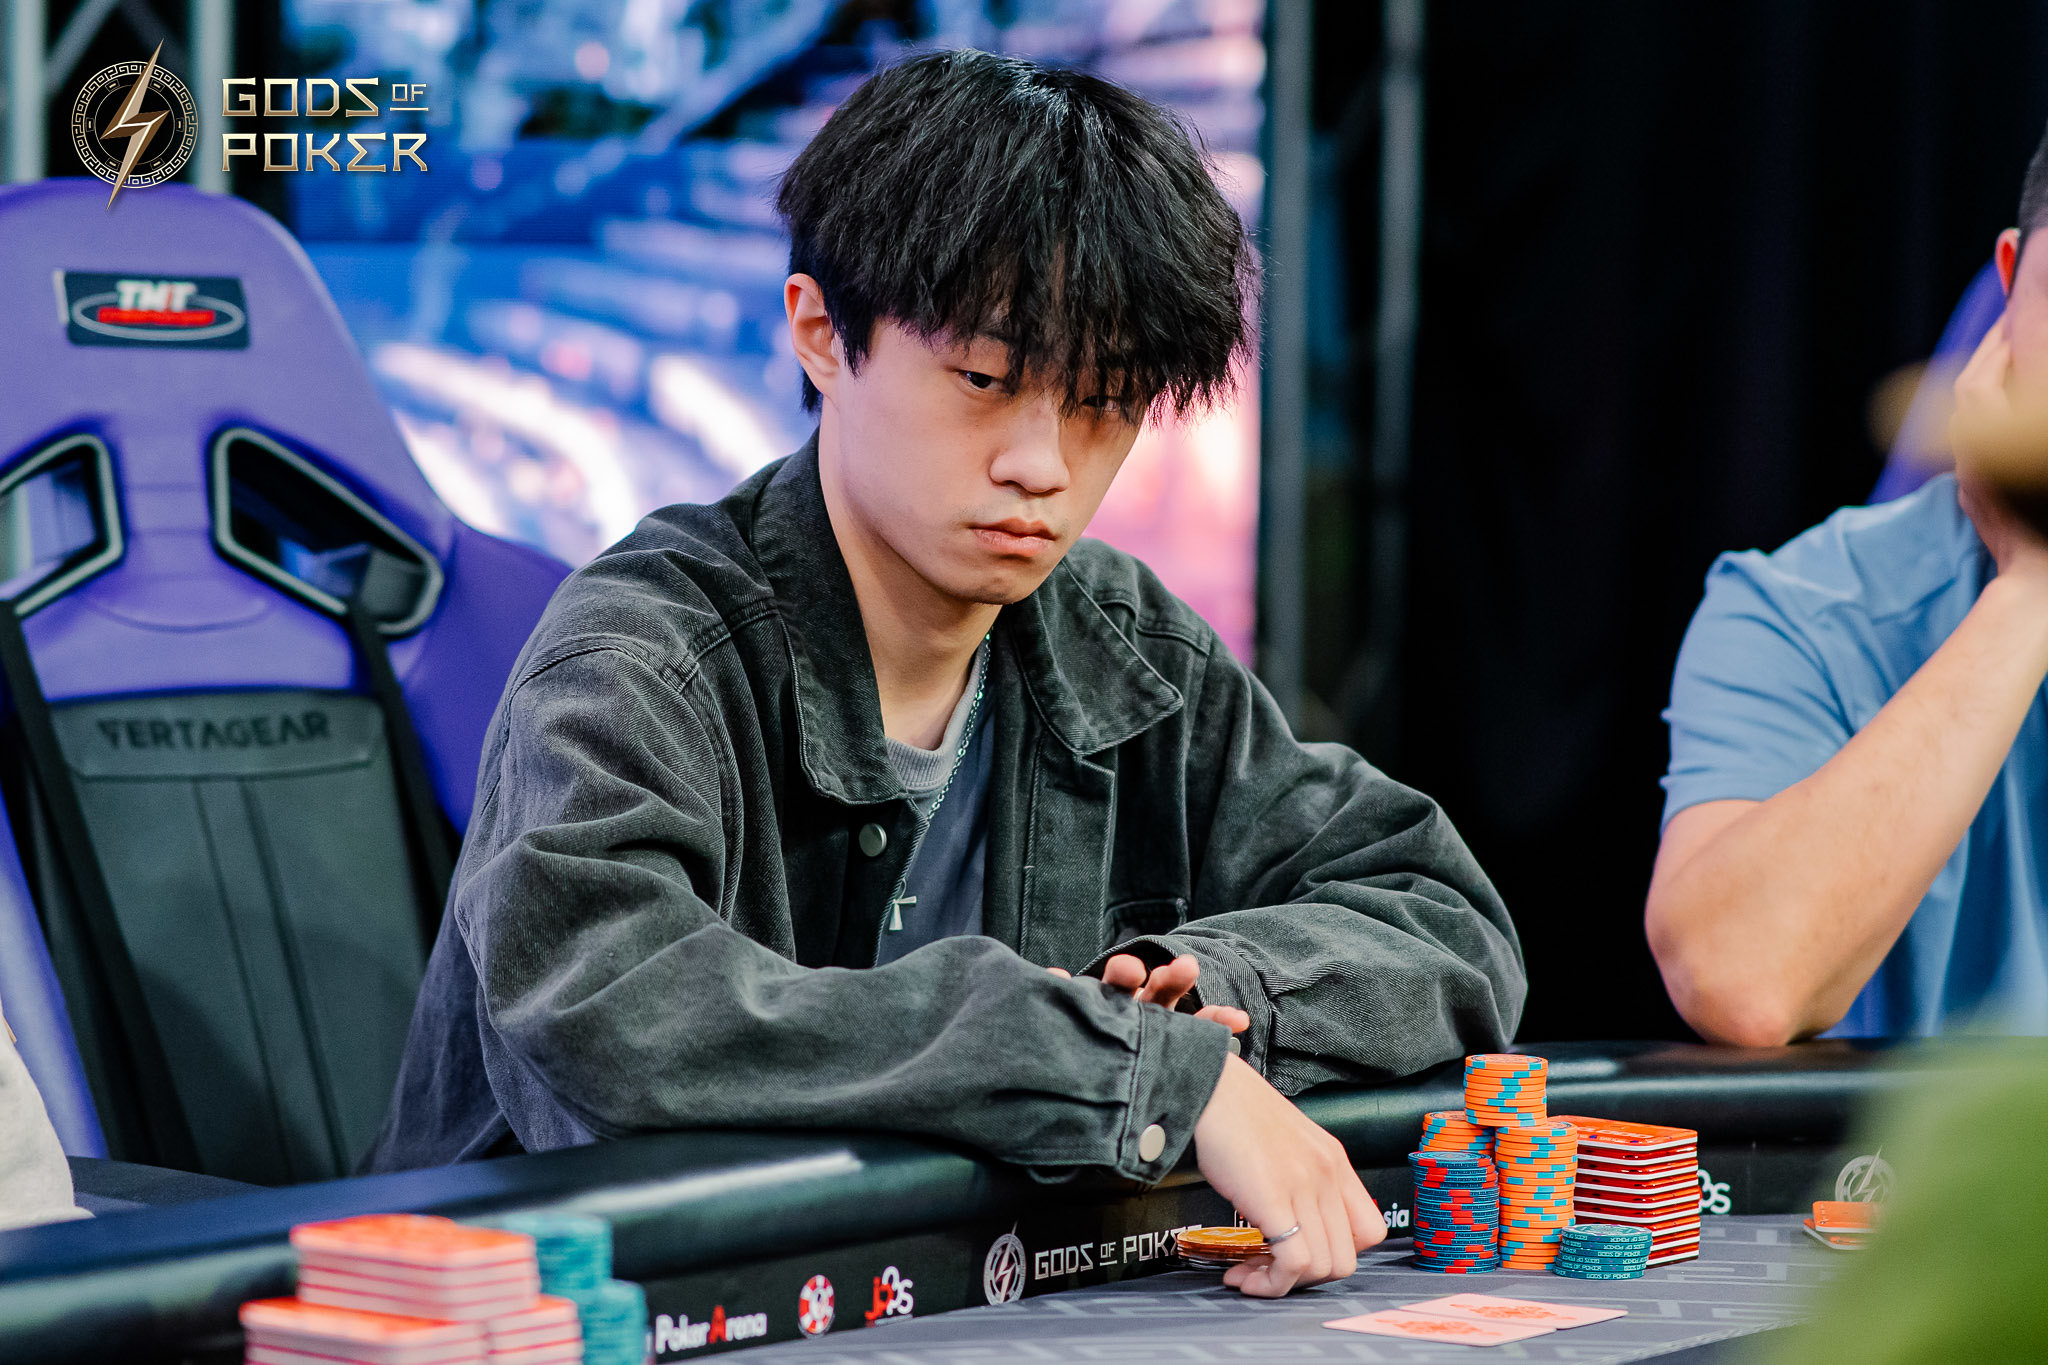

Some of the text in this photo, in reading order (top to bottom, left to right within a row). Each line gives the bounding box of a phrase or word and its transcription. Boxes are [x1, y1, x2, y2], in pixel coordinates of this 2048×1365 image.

[97, 711, 328, 750] VERTAGEAR
[1034, 1243, 1093, 1280] GODS
[1100, 1242, 1117, 1259] OF
